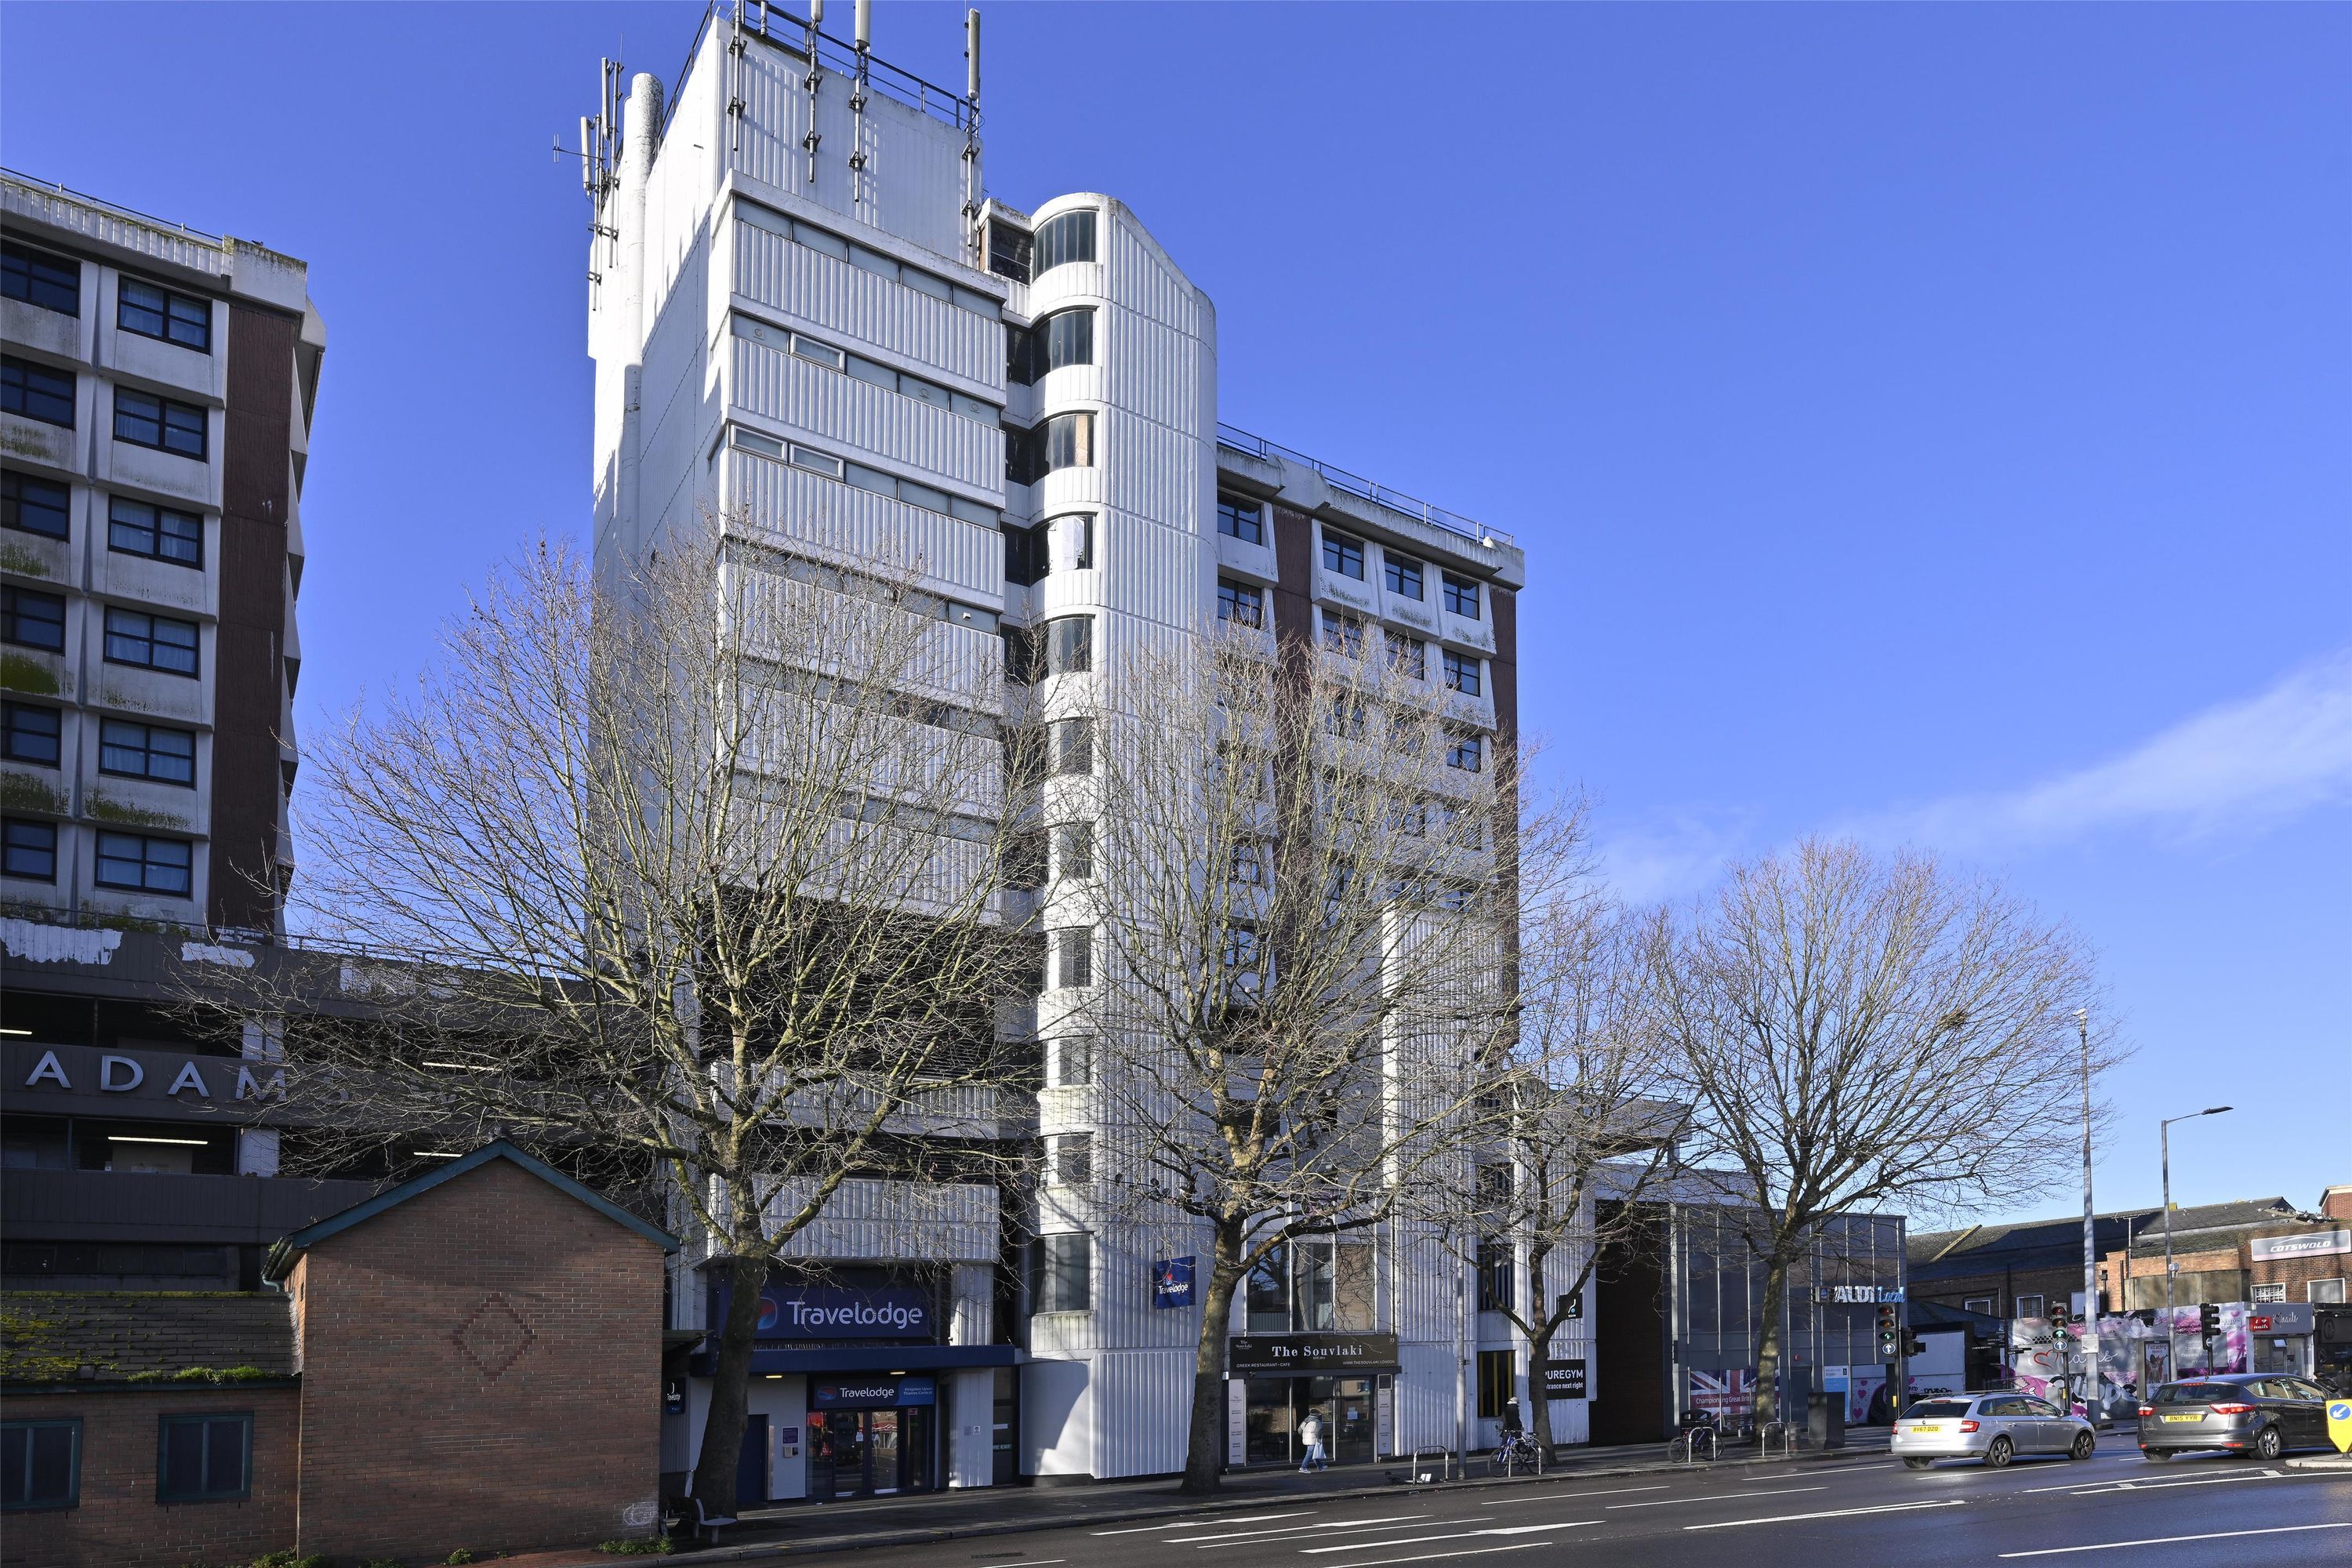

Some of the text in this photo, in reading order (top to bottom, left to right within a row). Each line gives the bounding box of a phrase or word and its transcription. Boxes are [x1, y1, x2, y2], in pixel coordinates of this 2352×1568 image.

[2270, 1240, 2331, 1252] COTSWOLD
[1159, 1283, 1189, 1294] Travelodge
[1835, 1286, 1875, 1303] ALDI
[1877, 1287, 1906, 1303] Local
[786, 1301, 923, 1330] Travelodge
[1272, 1345, 1363, 1357] The Souvlaki
[840, 1387, 895, 1399] Travelodge
[1696, 1396, 1729, 1405] Championng
